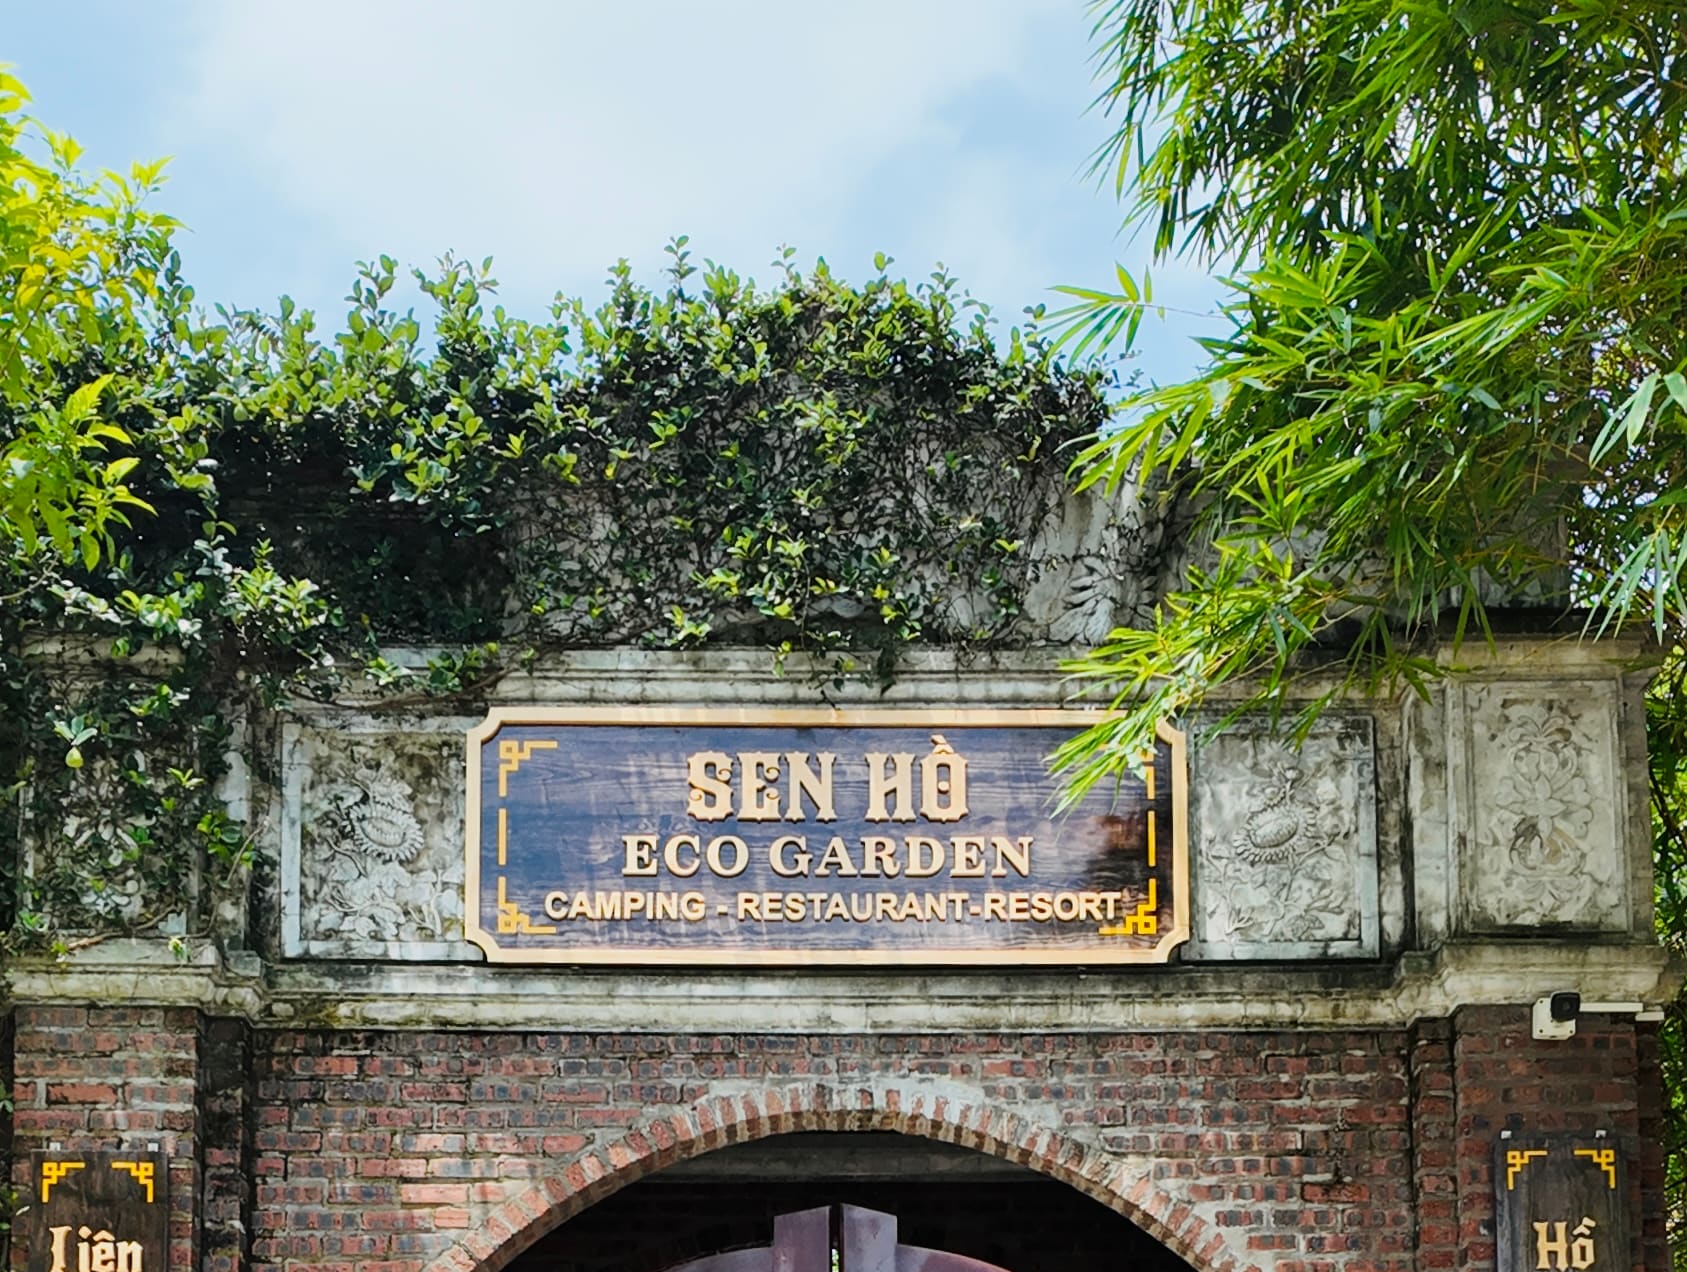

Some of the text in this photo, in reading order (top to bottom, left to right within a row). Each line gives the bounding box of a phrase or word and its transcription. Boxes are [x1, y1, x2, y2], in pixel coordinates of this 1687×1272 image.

[687, 734, 969, 823] SEN HỒ
[622, 834, 1033, 877] ECO GARDEN
[545, 890, 706, 921] CAMPING
[1532, 1216, 1596, 1272] Hồ
